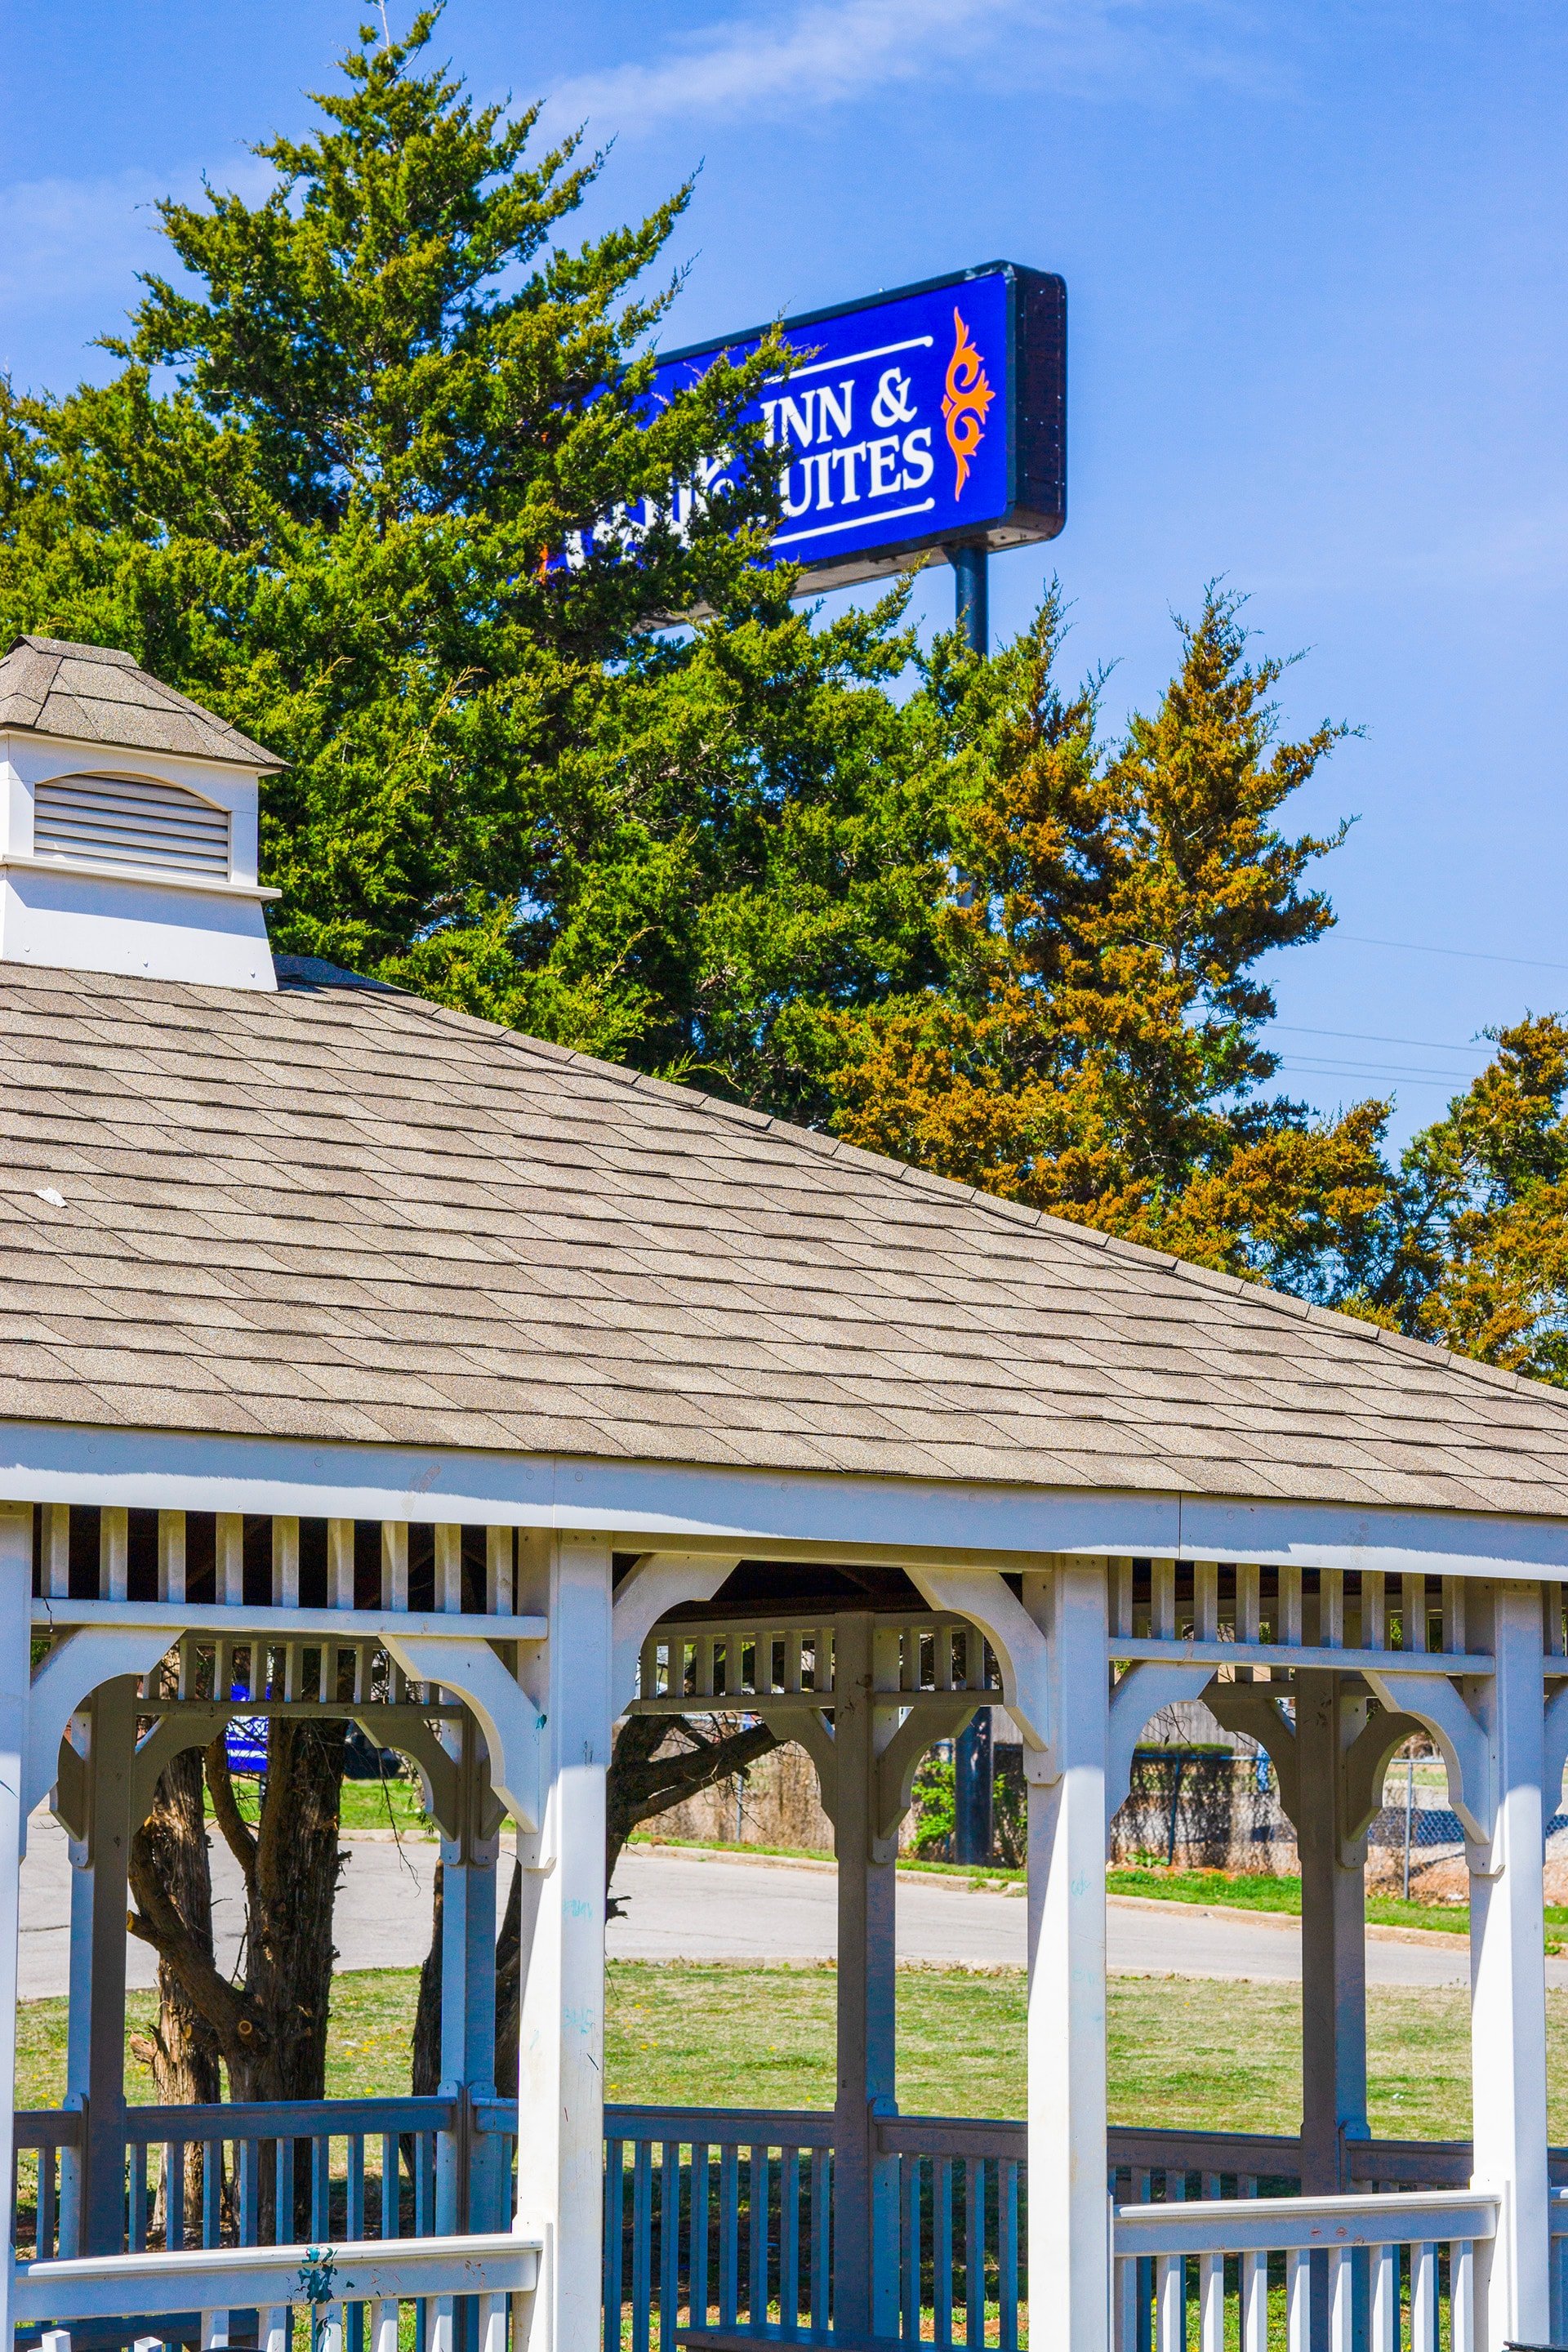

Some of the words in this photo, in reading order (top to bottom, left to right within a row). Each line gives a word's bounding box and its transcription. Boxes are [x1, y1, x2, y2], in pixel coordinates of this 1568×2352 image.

[760, 379, 855, 453] INN
[871, 367, 918, 428] &
[743, 426, 934, 524] UITES
